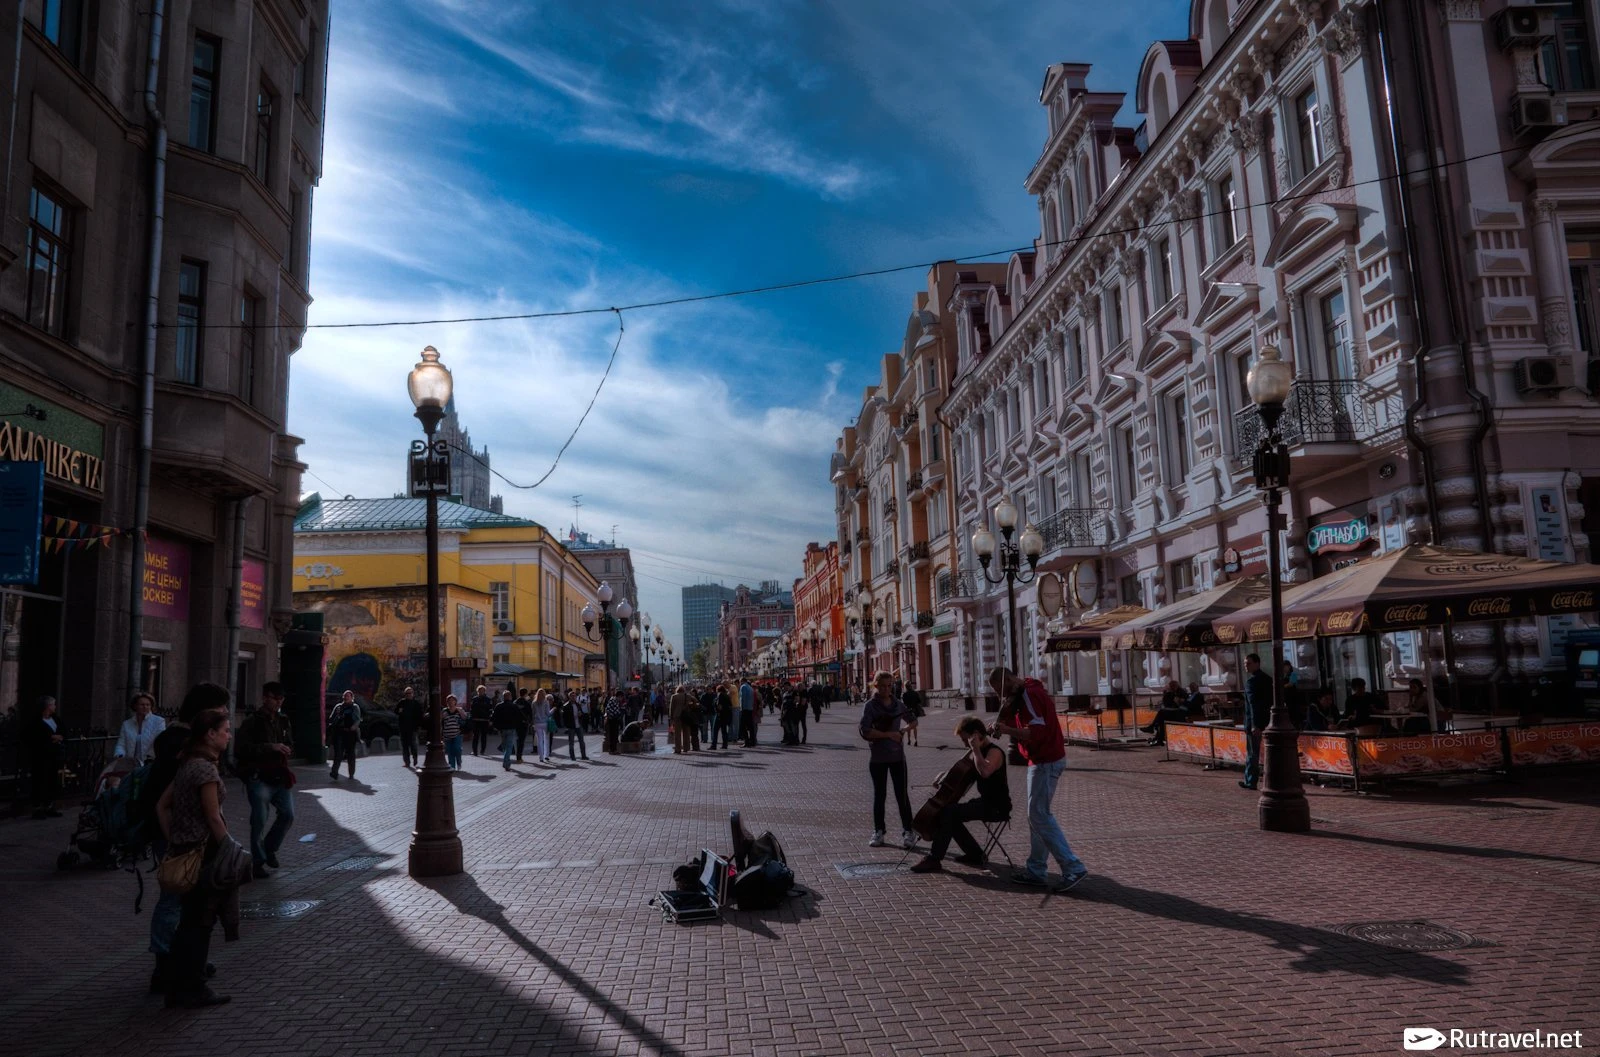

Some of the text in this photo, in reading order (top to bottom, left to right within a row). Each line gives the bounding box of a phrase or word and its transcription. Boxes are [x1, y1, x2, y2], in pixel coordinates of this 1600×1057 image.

[1308, 516, 1369, 550] СИННАБОН
[157, 574, 182, 590] ЦЕНЫ
[1392, 740, 1427, 751] NEEDS
[1432, 732, 1496, 748] frosting
